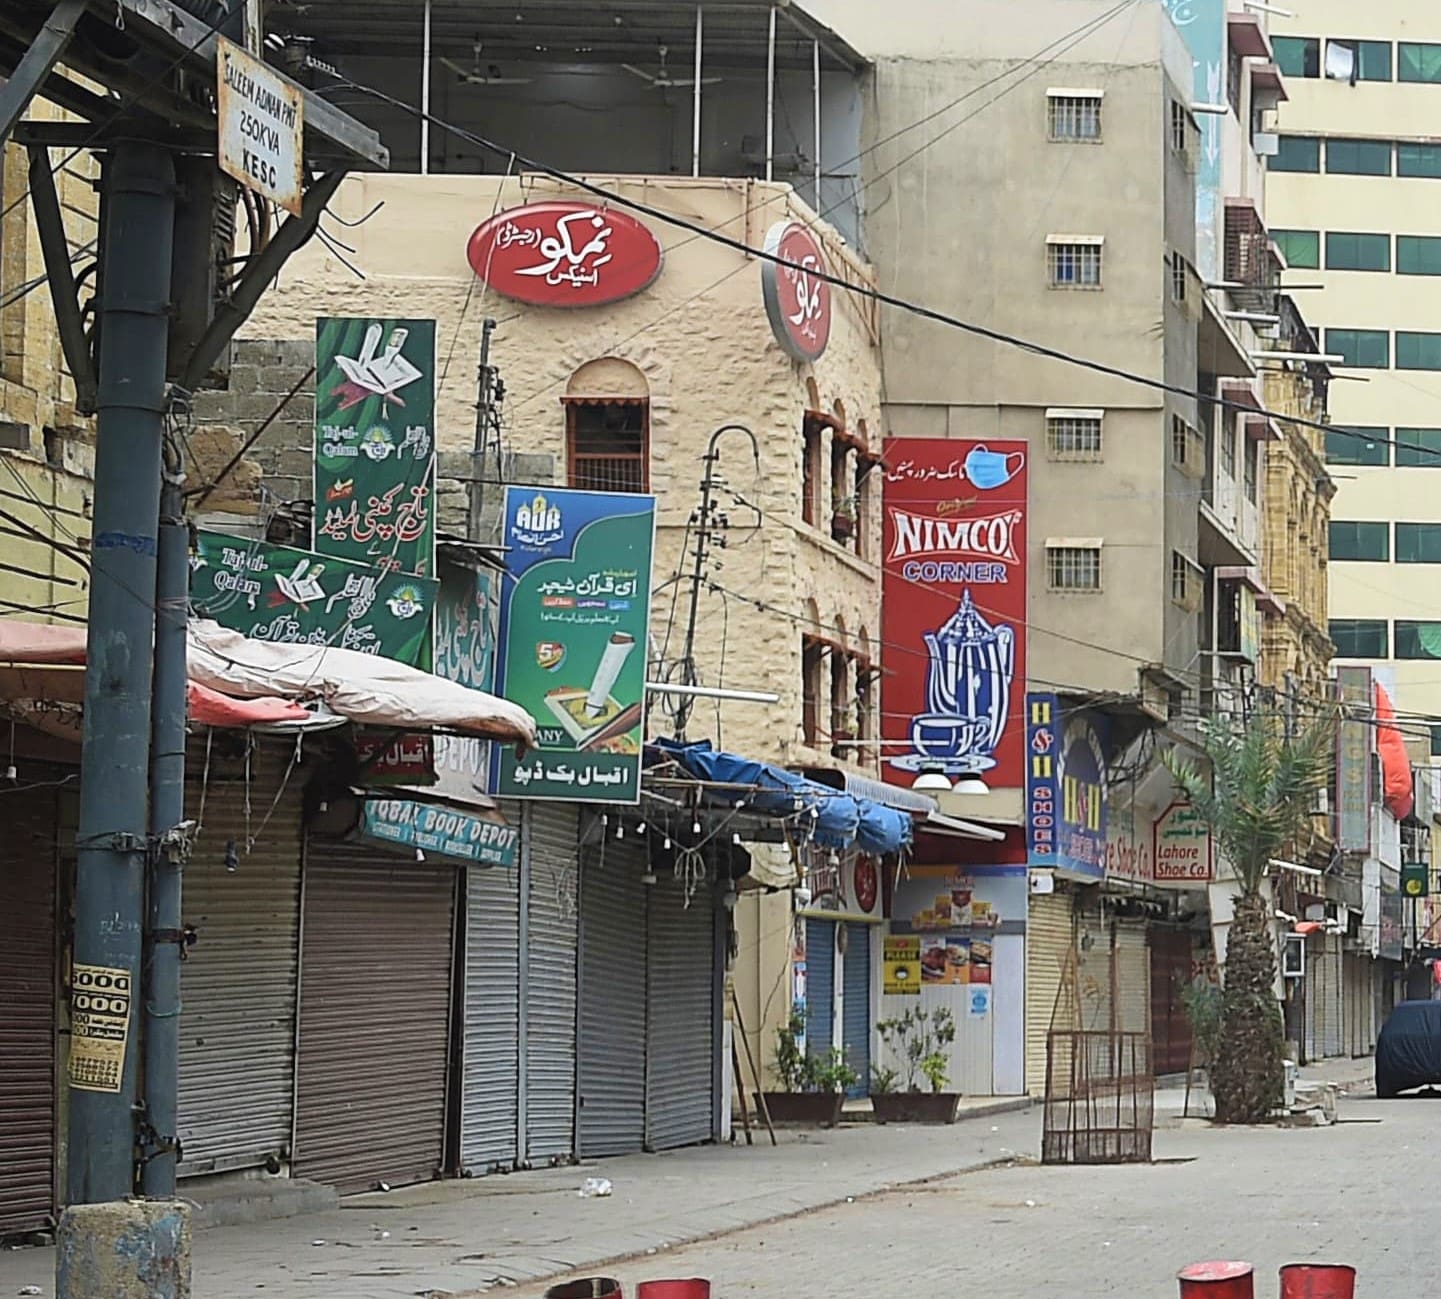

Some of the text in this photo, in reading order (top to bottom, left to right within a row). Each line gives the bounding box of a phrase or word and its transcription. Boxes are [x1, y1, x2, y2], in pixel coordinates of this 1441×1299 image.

[255, 83, 282, 121] ADNAN
[240, 110, 280, 156] 250KVA
[242, 147, 277, 189] KESC
[893, 512, 1012, 560] NIMCO
[904, 561, 1008, 583] CORNER
[513, 759, 629, 786] اقبال بک ڈپو
[1031, 701, 1054, 855] H & H SHOES
[369, 800, 421, 826] IQBAL
[424, 810, 468, 839] BOOK
[469, 821, 518, 850] DEPOT
[1157, 843, 1199, 860] Lahore
[1157, 861, 1208, 876] Shoe Co.
